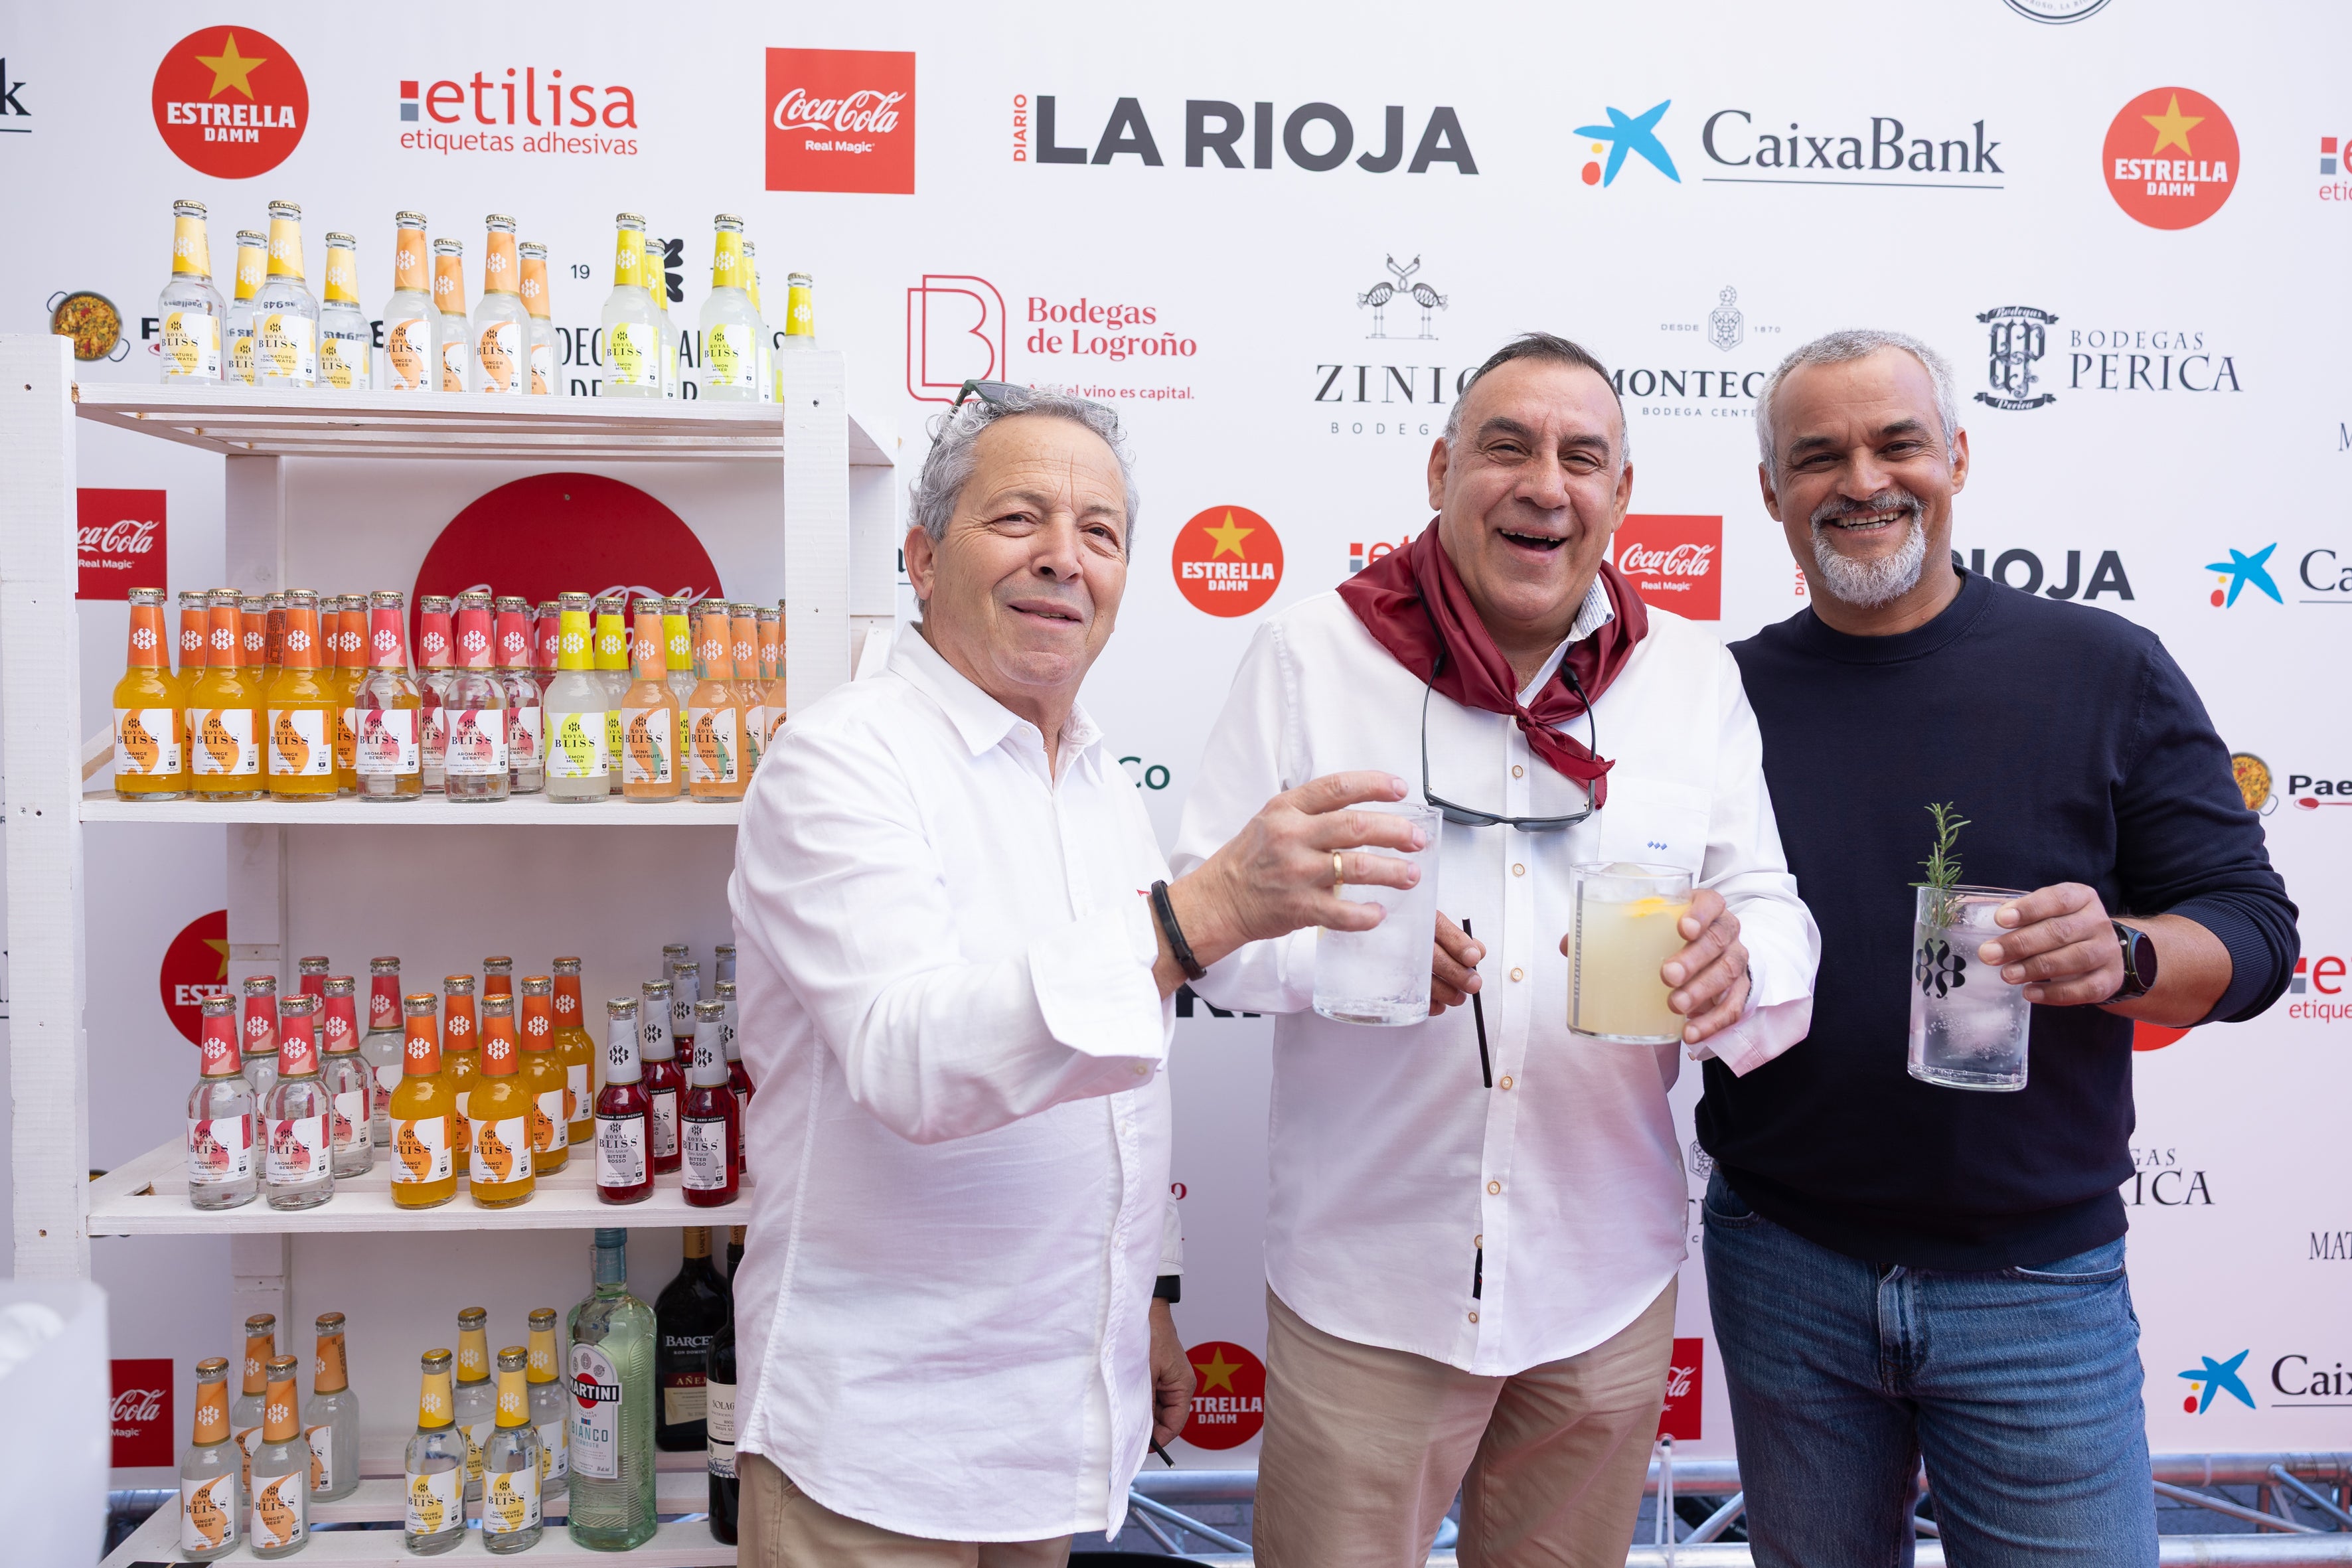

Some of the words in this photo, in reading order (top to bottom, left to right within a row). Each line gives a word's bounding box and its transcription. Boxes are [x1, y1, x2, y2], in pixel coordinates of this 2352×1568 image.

[167, 102, 296, 129] ESTRELLA
[773, 88, 907, 134] Coca-Cola
[1014, 94, 1027, 162] DIARIO
[204, 127, 260, 143] DAMM
[1036, 95, 1164, 167] LA
[1185, 99, 1480, 175] RIOJA
[400, 129, 514, 155] etiquetas
[522, 132, 638, 156] adhesivas
[805, 139, 831, 152] Real
[834, 140, 872, 154] Magic
[1702, 110, 2005, 174] CaixaBank
[2114, 157, 2229, 183] ESTRELLA
[2146, 181, 2195, 197] DAMM
[1027, 296, 1156, 331] Bodegas
[162, 337, 198, 347] BLISS
[259, 340, 297, 349] BLISS
[1027, 330, 1063, 354] de
[1072, 331, 1197, 362] Logroño
[2070, 329, 2204, 351] BODEGAS
[386, 344, 422, 353] BLISS
[607, 348, 642, 357] BLISS
[2068, 351, 2244, 393] PERICA
[1083, 384, 1116, 398] vino
[1120, 388, 1136, 398] es
[1140, 386, 1195, 402] capital.
[1642, 407, 1702, 416] BODEGA
[1331, 422, 1429, 435] BODEG
[77, 519, 160, 553] ca-Cola
[78, 559, 100, 568] Real
[102, 559, 133, 570] Magic
[1618, 542, 1717, 577] Coca-Cola
[1182, 562, 1275, 581] ESTRELLA
[1952, 548, 2135, 601] IOJA
[1208, 579, 1249, 592] DAMM
[1641, 581, 1661, 590] Real
[1664, 581, 1690, 592] Magic
[118, 736, 158, 744] BLISS
[271, 736, 309, 745] BLISS
[360, 736, 398, 744] BLISS
[451, 736, 492, 745] BLISS
[625, 734, 663, 744] BLISS
[190, 1144, 228, 1154] BLISS
[270, 1144, 309, 1154] BLISS
[394, 1144, 431, 1154] BLISS
[474, 1144, 512, 1154] BLISS
[599, 1138, 637, 1148] BLISS
[682, 1140, 718, 1151] BLISS
[665, 1335, 713, 1348] BARCE
[676, 1373, 706, 1385] AÑEJ
[570, 1375, 617, 1401] MARTINI
[712, 1399, 735, 1410] SOLAG
[1198, 1413, 1237, 1425] DAMM
[110, 1428, 139, 1438] Magic
[572, 1420, 609, 1443] BIANCO
[576, 1437, 599, 1449] VERMOUTH
[255, 1498, 295, 1511] BLISS
[408, 1496, 443, 1507] BLISS
[489, 1494, 524, 1505] BLISS
[186, 1500, 226, 1514] BLISS
